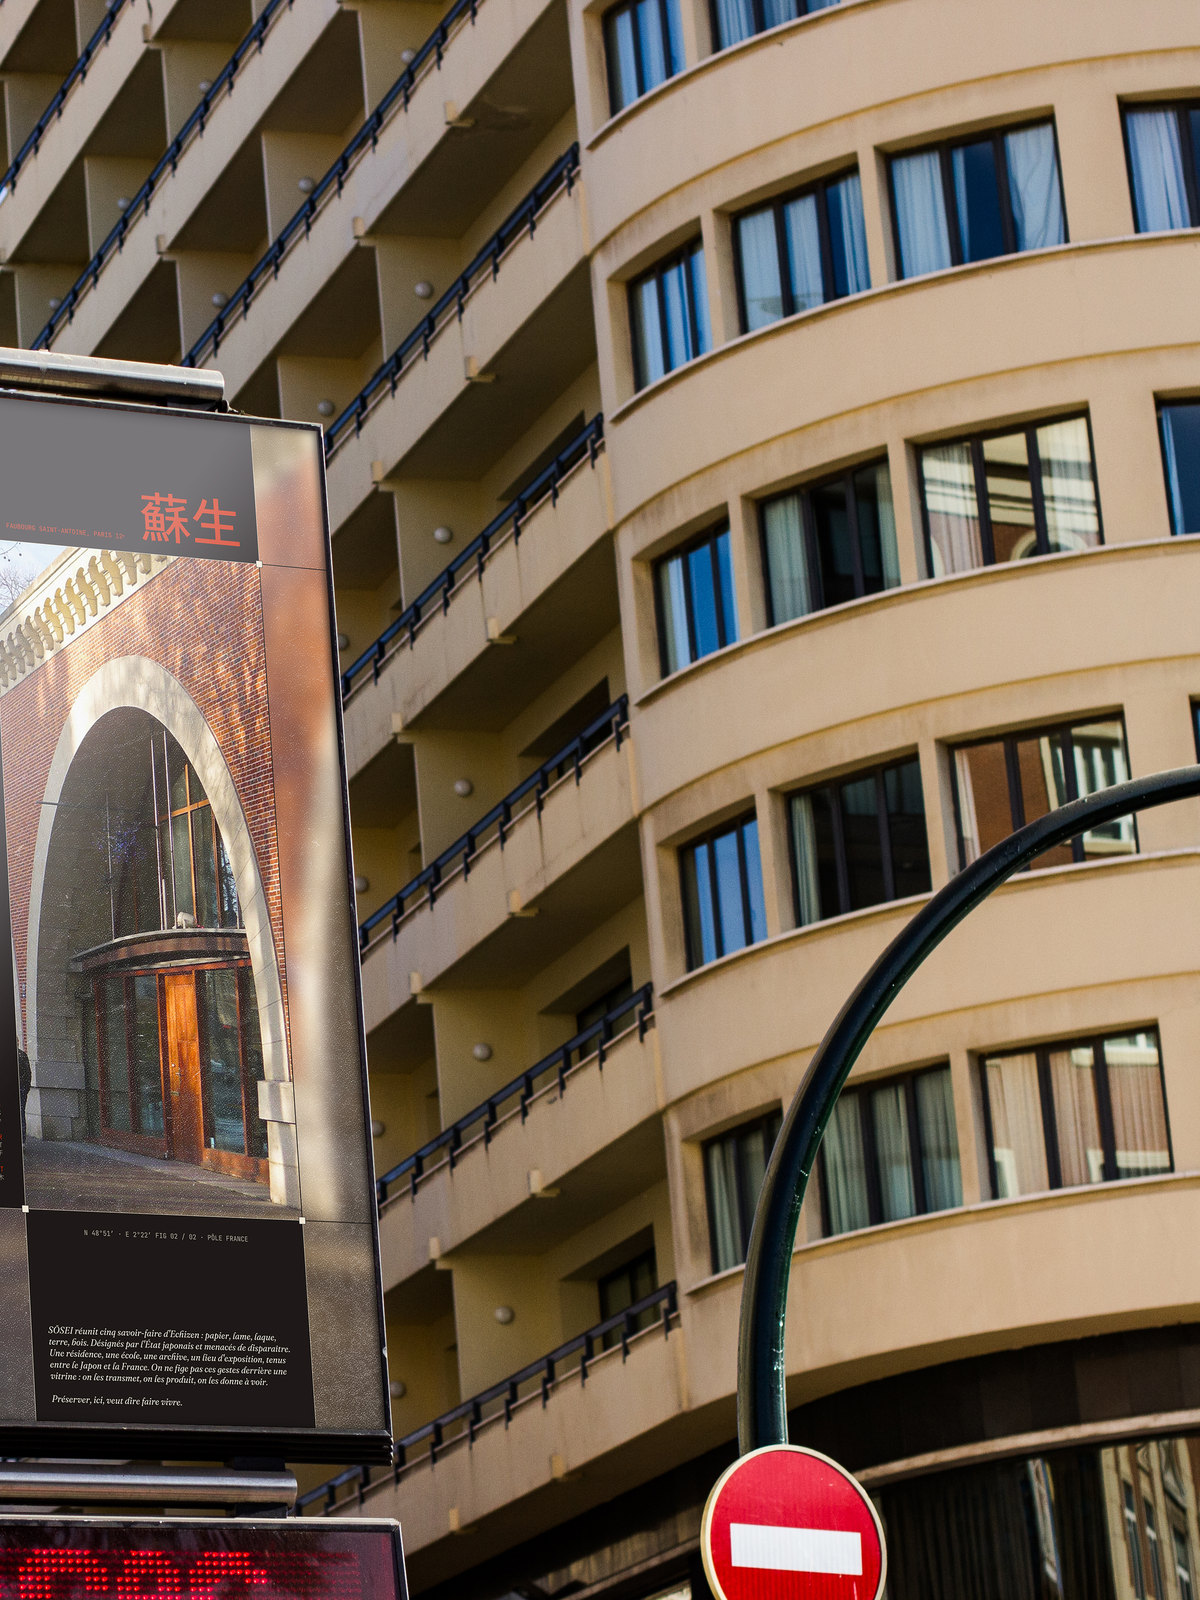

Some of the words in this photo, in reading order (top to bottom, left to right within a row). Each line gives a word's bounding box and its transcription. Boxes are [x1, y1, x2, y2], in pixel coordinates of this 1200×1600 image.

[140, 492, 241, 547] 蘇生
[6, 522, 36, 532] FAUBOURG
[39, 526, 89, 536] SAINT-ANTOINE,
[207, 1234, 222, 1242] PÔLE
[100, 1328, 116, 1338] cinq
[117, 1328, 162, 1338] savoir-faire
[205, 1332, 231, 1341] papier,
[232, 1332, 252, 1341] lame,
[254, 1333, 277, 1343] laque,
[71, 1338, 88, 1346] bois.
[91, 1338, 124, 1349] Désignés
[125, 1341, 139, 1350] par
[161, 1342, 194, 1351] japonais
[50, 1349, 64, 1357] Une
[66, 1350, 104, 1359] résidence,
[121, 1351, 142, 1360] école,
[159, 1353, 189, 1361] archive,
[72, 1361, 78, 1369] le
[80, 1362, 102, 1371] Japon
[112, 1362, 119, 1370] la
[122, 1363, 149, 1371] France.
[151, 1363, 163, 1372] On
[174, 1364, 189, 1374] fige
[217, 1367, 240, 1375] gestes
[241, 1366, 272, 1375] derrière
[50, 1372, 77, 1380] vitrine
[94, 1373, 104, 1381] les
[154, 1375, 164, 1383] les
[166, 1376, 196, 1385] produit,
[209, 1376, 218, 1385] les
[220, 1377, 243, 1385] donne
[52, 1395, 92, 1405] Préserver,
[94, 1396, 105, 1405] ici,
[125, 1397, 140, 1405] dire
[141, 1397, 160, 1406] faire
